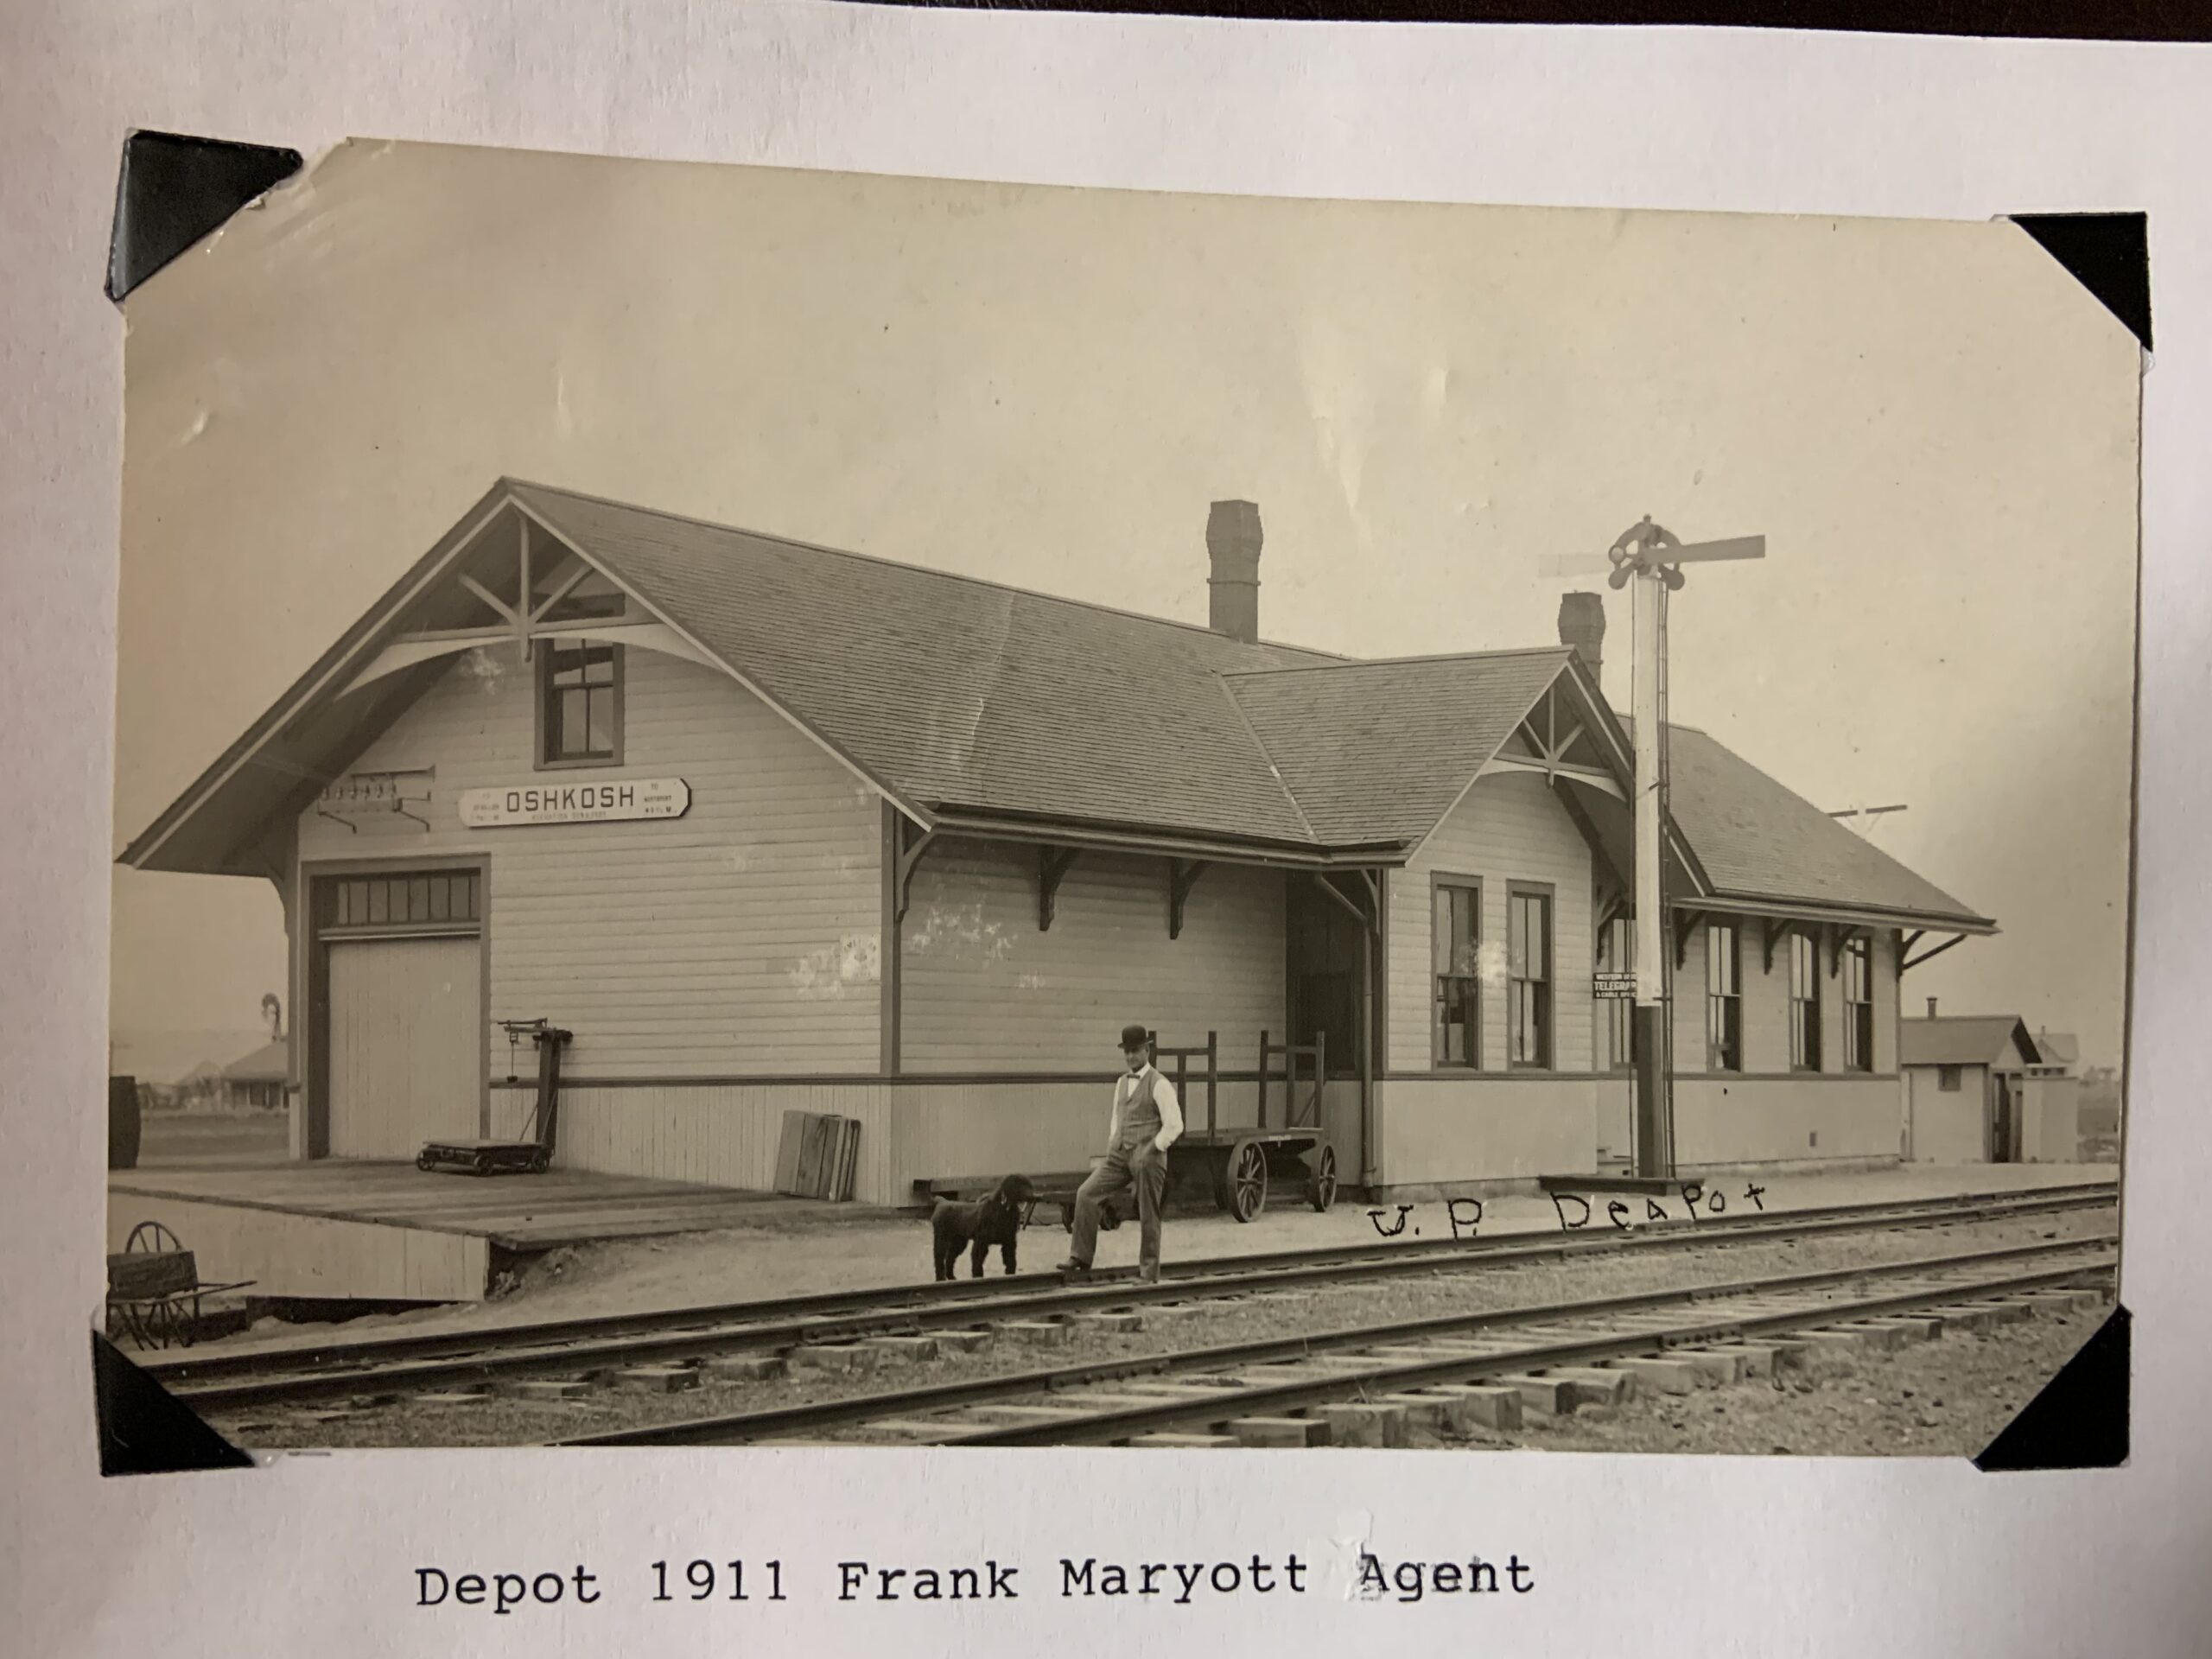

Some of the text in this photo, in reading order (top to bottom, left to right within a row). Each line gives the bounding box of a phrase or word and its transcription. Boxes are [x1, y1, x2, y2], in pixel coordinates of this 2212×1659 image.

[506, 785, 634, 813] OSHKOSH
[414, 1553, 1535, 1615] Depot 1911 Frank Maryott Agent
